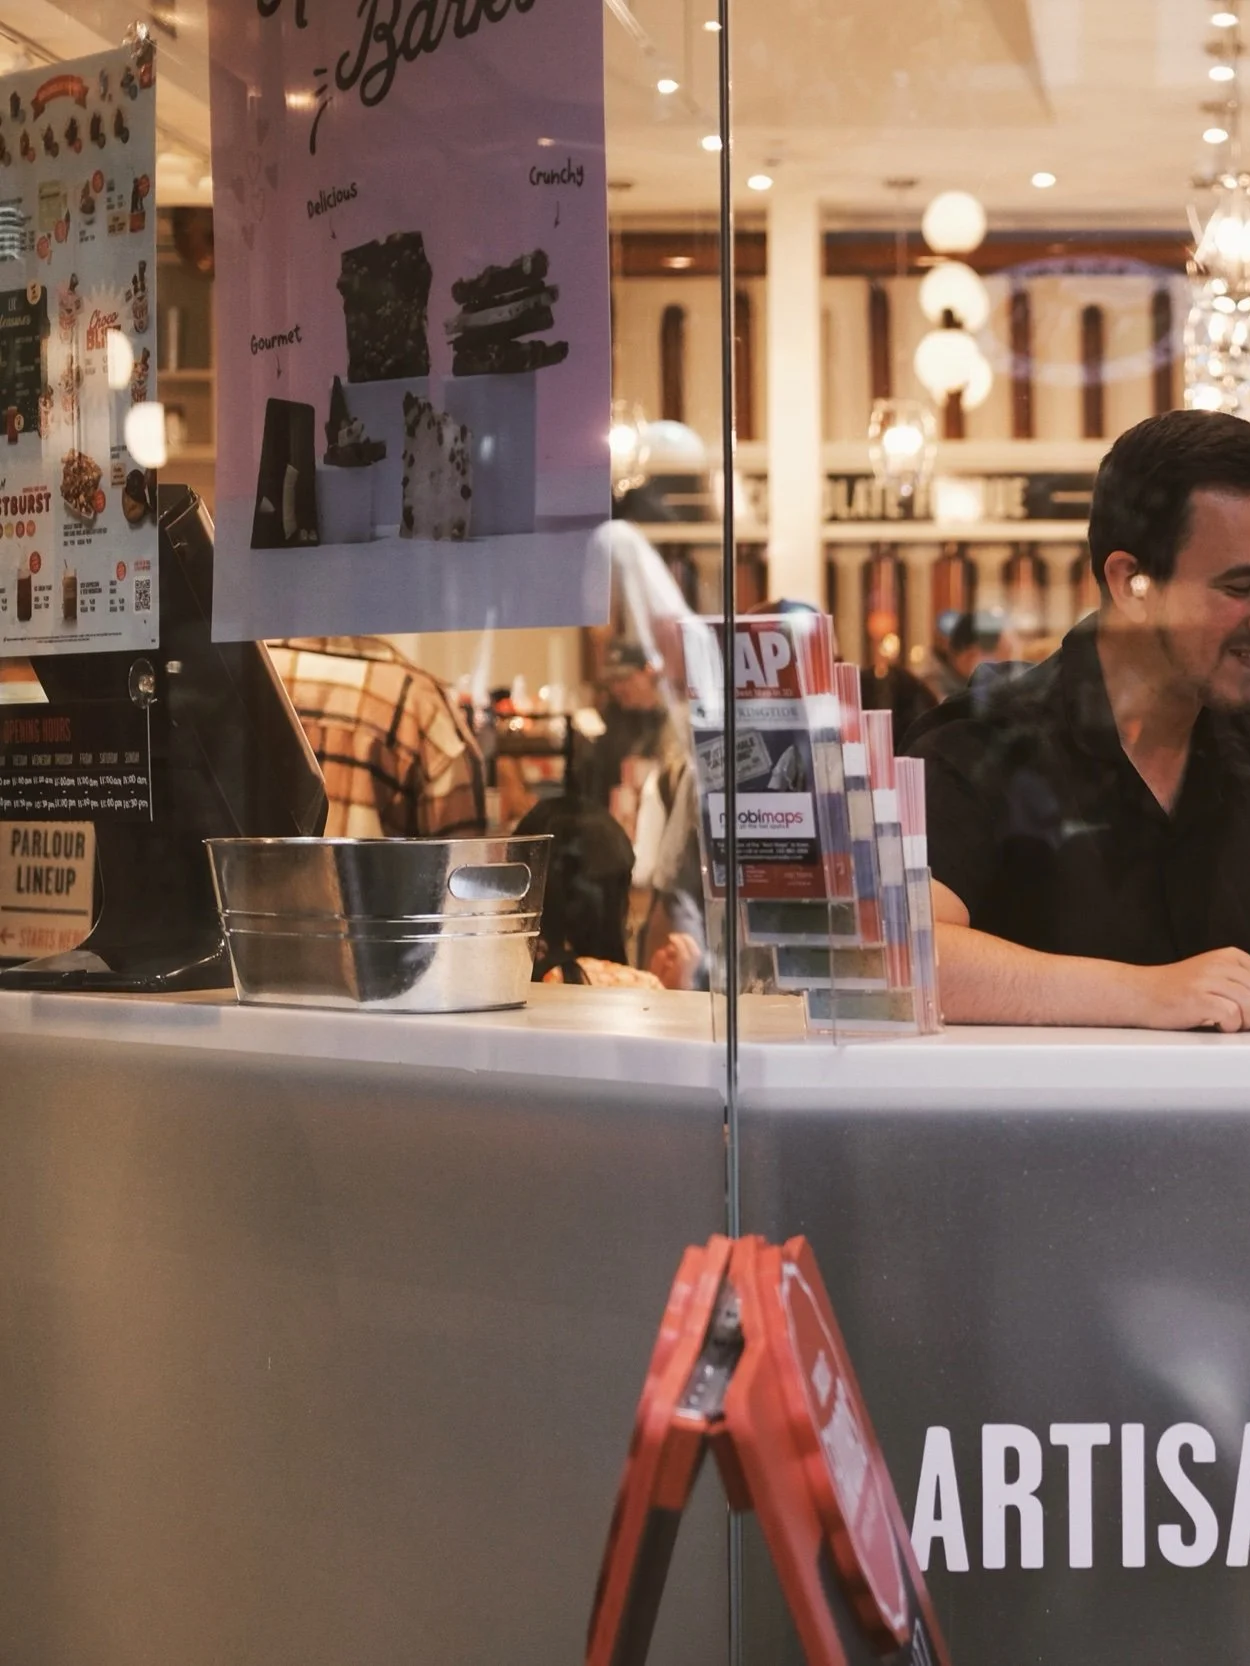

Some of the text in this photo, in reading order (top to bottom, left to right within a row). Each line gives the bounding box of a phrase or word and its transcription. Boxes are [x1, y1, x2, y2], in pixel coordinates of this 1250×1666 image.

[529, 157, 584, 187] Crunchy
[307, 182, 357, 219] Delicious
[250, 324, 302, 354] Gourmet
[0, 492, 51, 516] TBURST
[10, 828, 86, 859] PARLOUR
[16, 864, 76, 896] LINEUP
